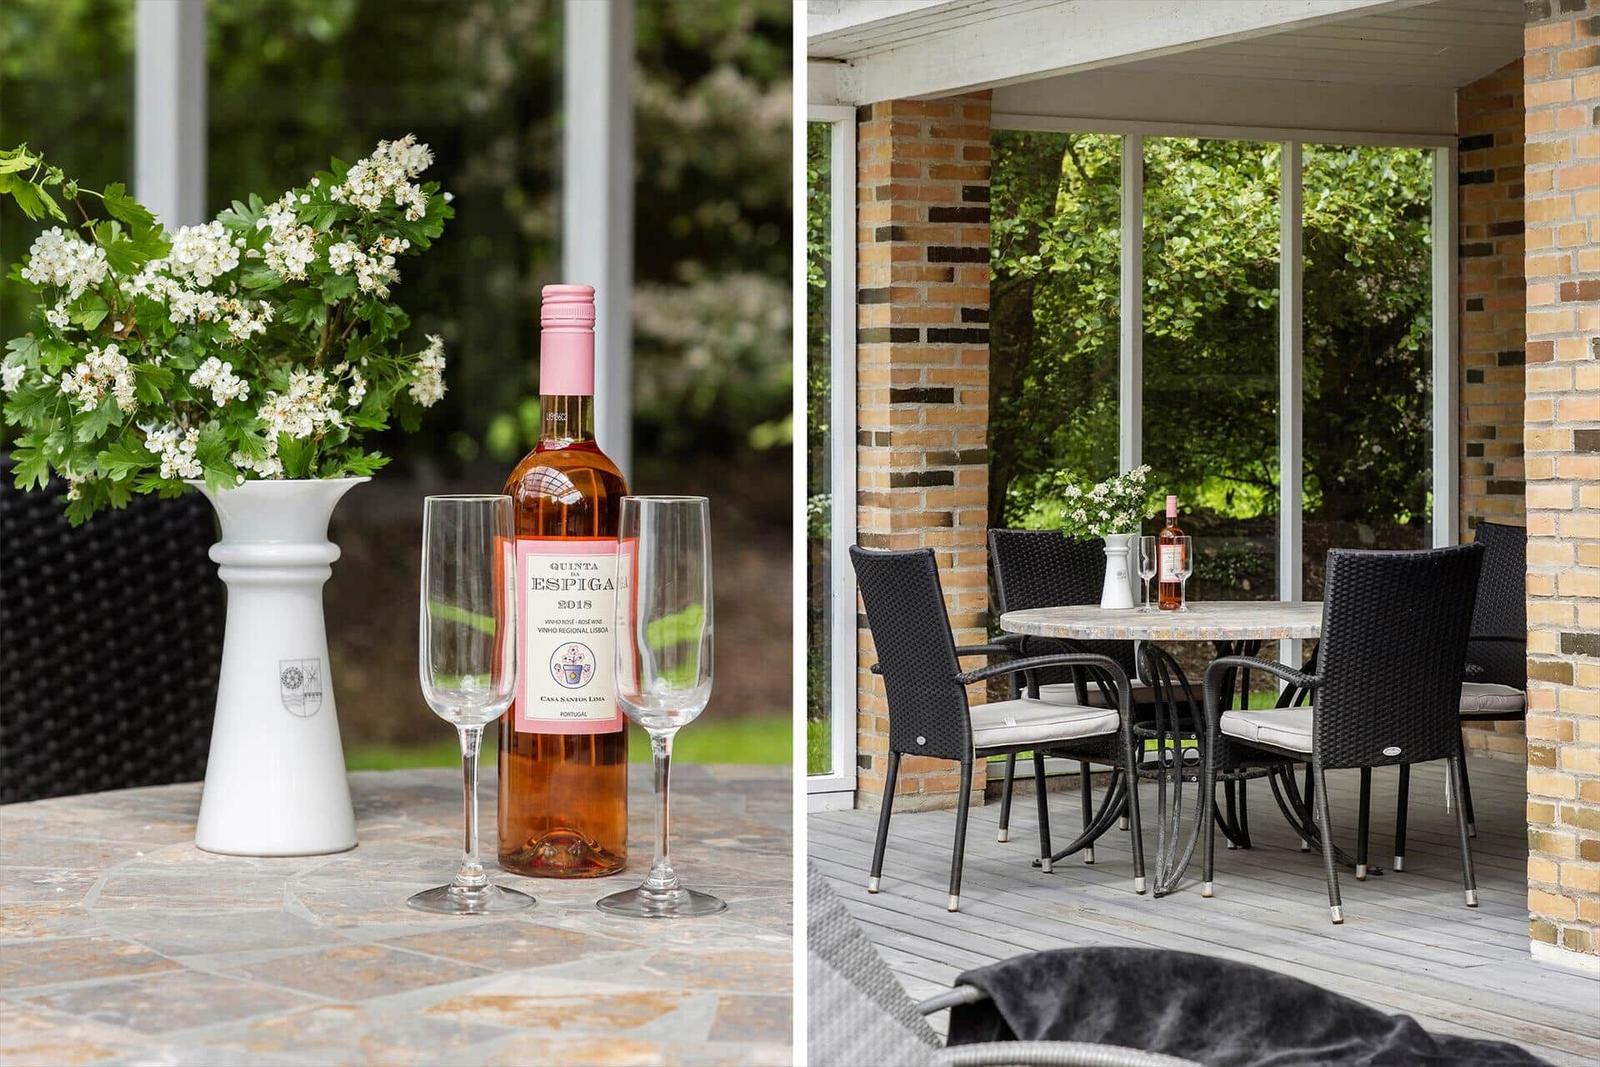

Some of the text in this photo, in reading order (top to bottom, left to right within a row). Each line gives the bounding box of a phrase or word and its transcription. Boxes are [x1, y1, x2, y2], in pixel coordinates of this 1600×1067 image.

[550, 562, 598, 570] QUINTA
[532, 578, 614, 591] ESPIGA
[558, 600, 592, 609] 2018
